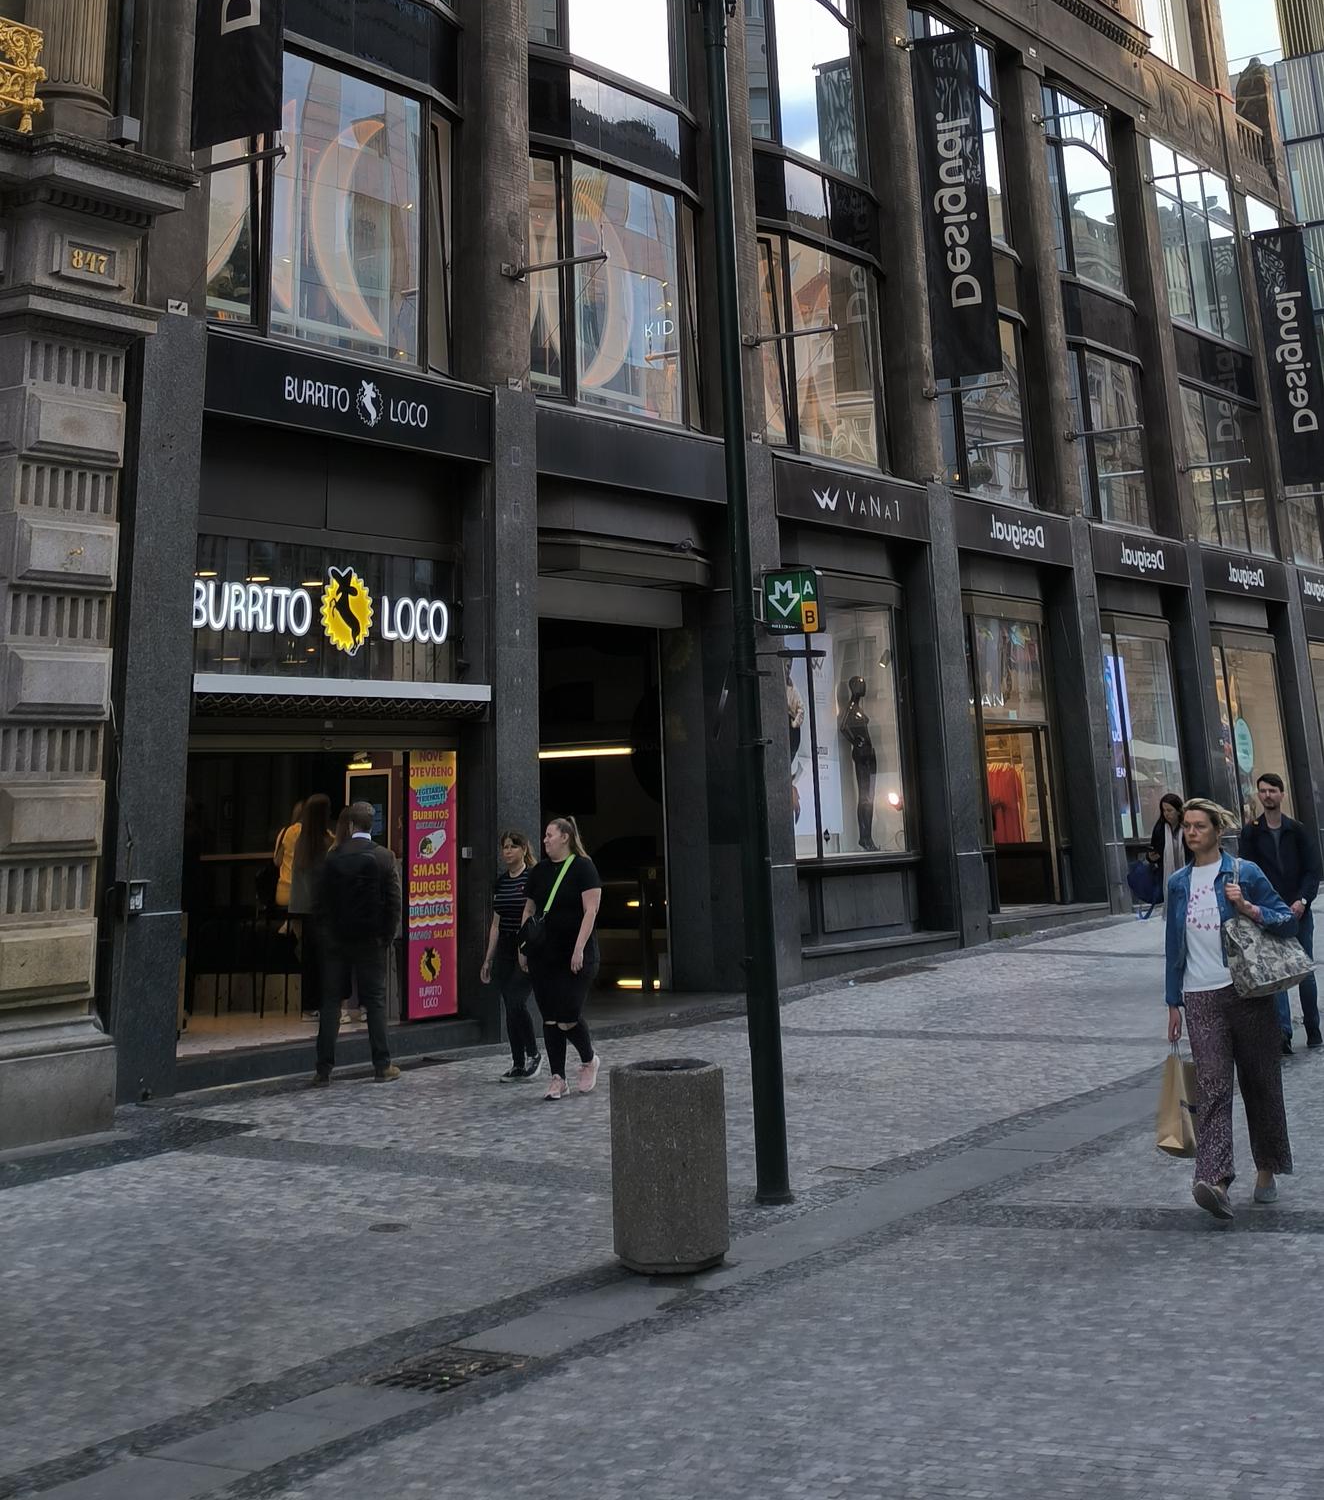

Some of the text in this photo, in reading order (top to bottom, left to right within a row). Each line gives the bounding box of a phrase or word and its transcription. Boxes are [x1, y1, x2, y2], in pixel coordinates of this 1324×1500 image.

[72, 249, 109, 274] 847
[284, 376, 428, 428] BURRITO LOCO
[803, 580, 814, 595] A
[192, 579, 449, 644] BURRITO LOCO
[804, 610, 815, 624] B
[410, 764, 454, 778] OTEVŘENO
[412, 810, 449, 820] BURRITOS
[413, 862, 449, 877] SMASH
[409, 880, 452, 893] BURGERS
[409, 904, 453, 917] BREAKFAST
